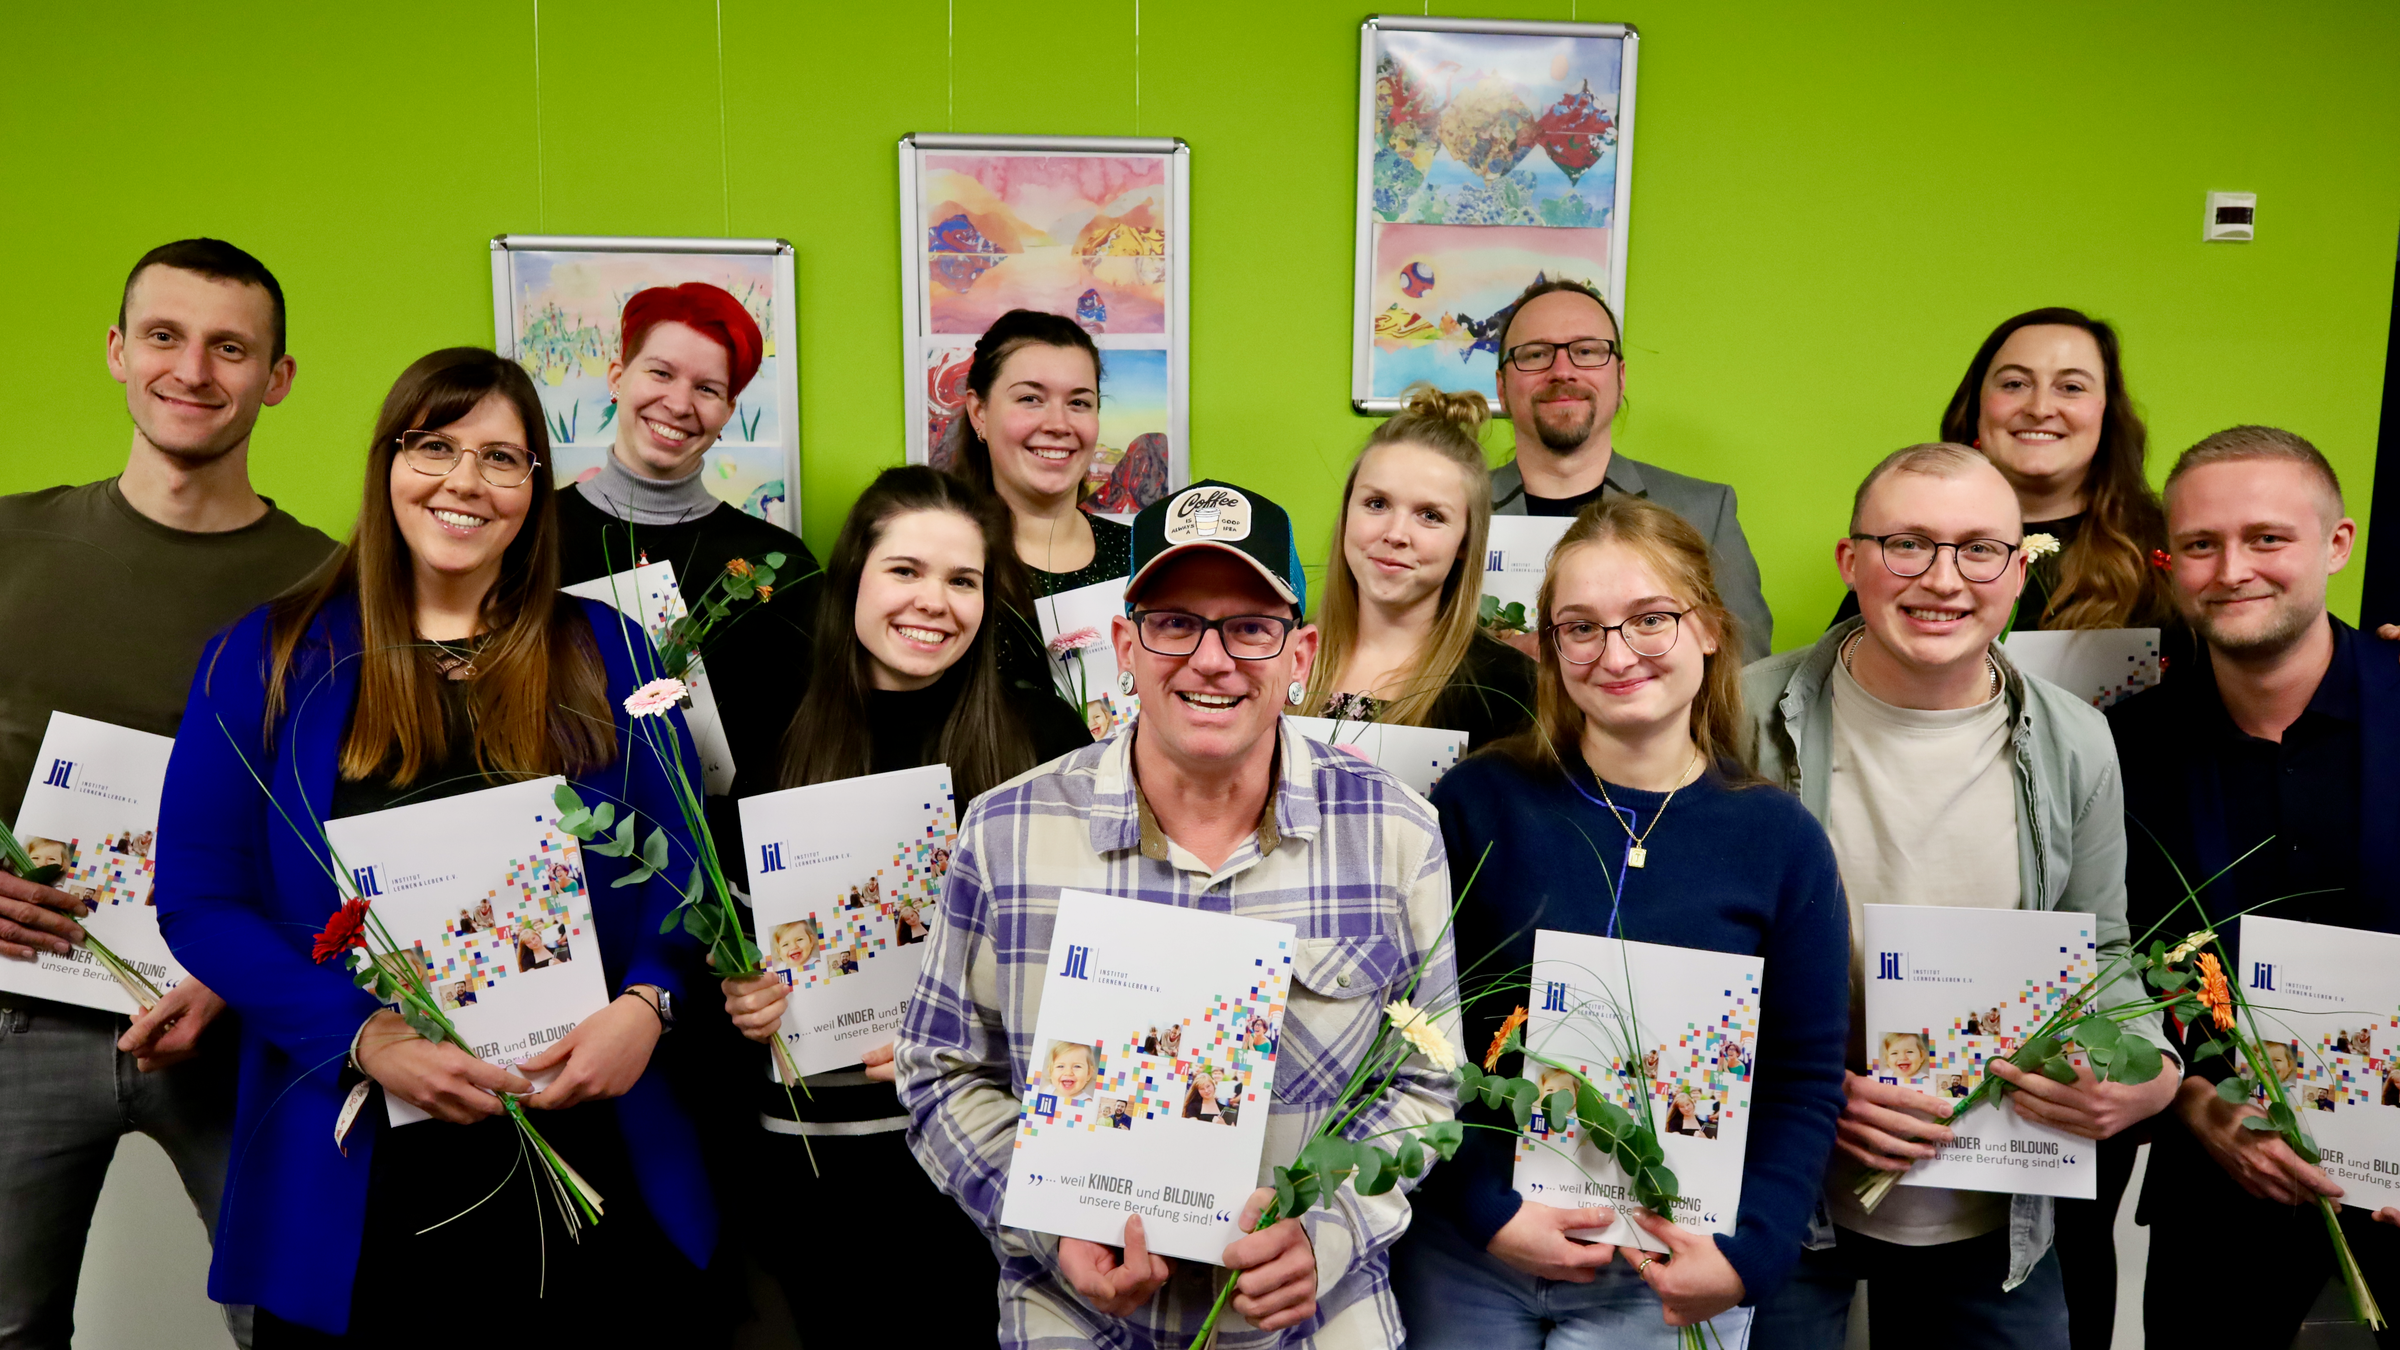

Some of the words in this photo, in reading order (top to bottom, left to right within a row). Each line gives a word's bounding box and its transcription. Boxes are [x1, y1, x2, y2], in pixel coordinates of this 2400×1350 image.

[1178, 491, 1238, 518] Coffee
[1171, 524, 1195, 533] ALWAYS
[82, 781, 109, 791] INSTITUT
[794, 851, 820, 860] INSTITUT
[391, 874, 421, 885] INSTITUT
[41, 962, 80, 976] unsere
[1099, 969, 1128, 979] INSTITUT
[2285, 982, 2313, 990] INSTITUT
[813, 1020, 835, 1033] weil
[836, 1008, 875, 1028] KINDER
[878, 1006, 898, 1019] und
[834, 1027, 869, 1042] unsere
[871, 1018, 902, 1033] Beruf
[504, 1038, 527, 1053] und
[1985, 1142, 2007, 1152] und
[2010, 1139, 2059, 1155] BILDUNG
[1935, 1153, 1973, 1162] unsere
[1976, 1153, 2029, 1169] Berufung
[2347, 1158, 2370, 1170] und
[2373, 1159, 2400, 1176] BILD
[2338, 1167, 2392, 1189] Berufung
[1060, 1174, 1086, 1188] weil
[1088, 1173, 1134, 1196] KINDER
[1136, 1187, 1161, 1201] und
[1163, 1186, 1215, 1210] BILDUNG
[1558, 1183, 1582, 1195] weil
[1584, 1181, 1625, 1201] KINDER
[1079, 1194, 1121, 1210] unsere
[1124, 1201, 1181, 1223] Berufung
